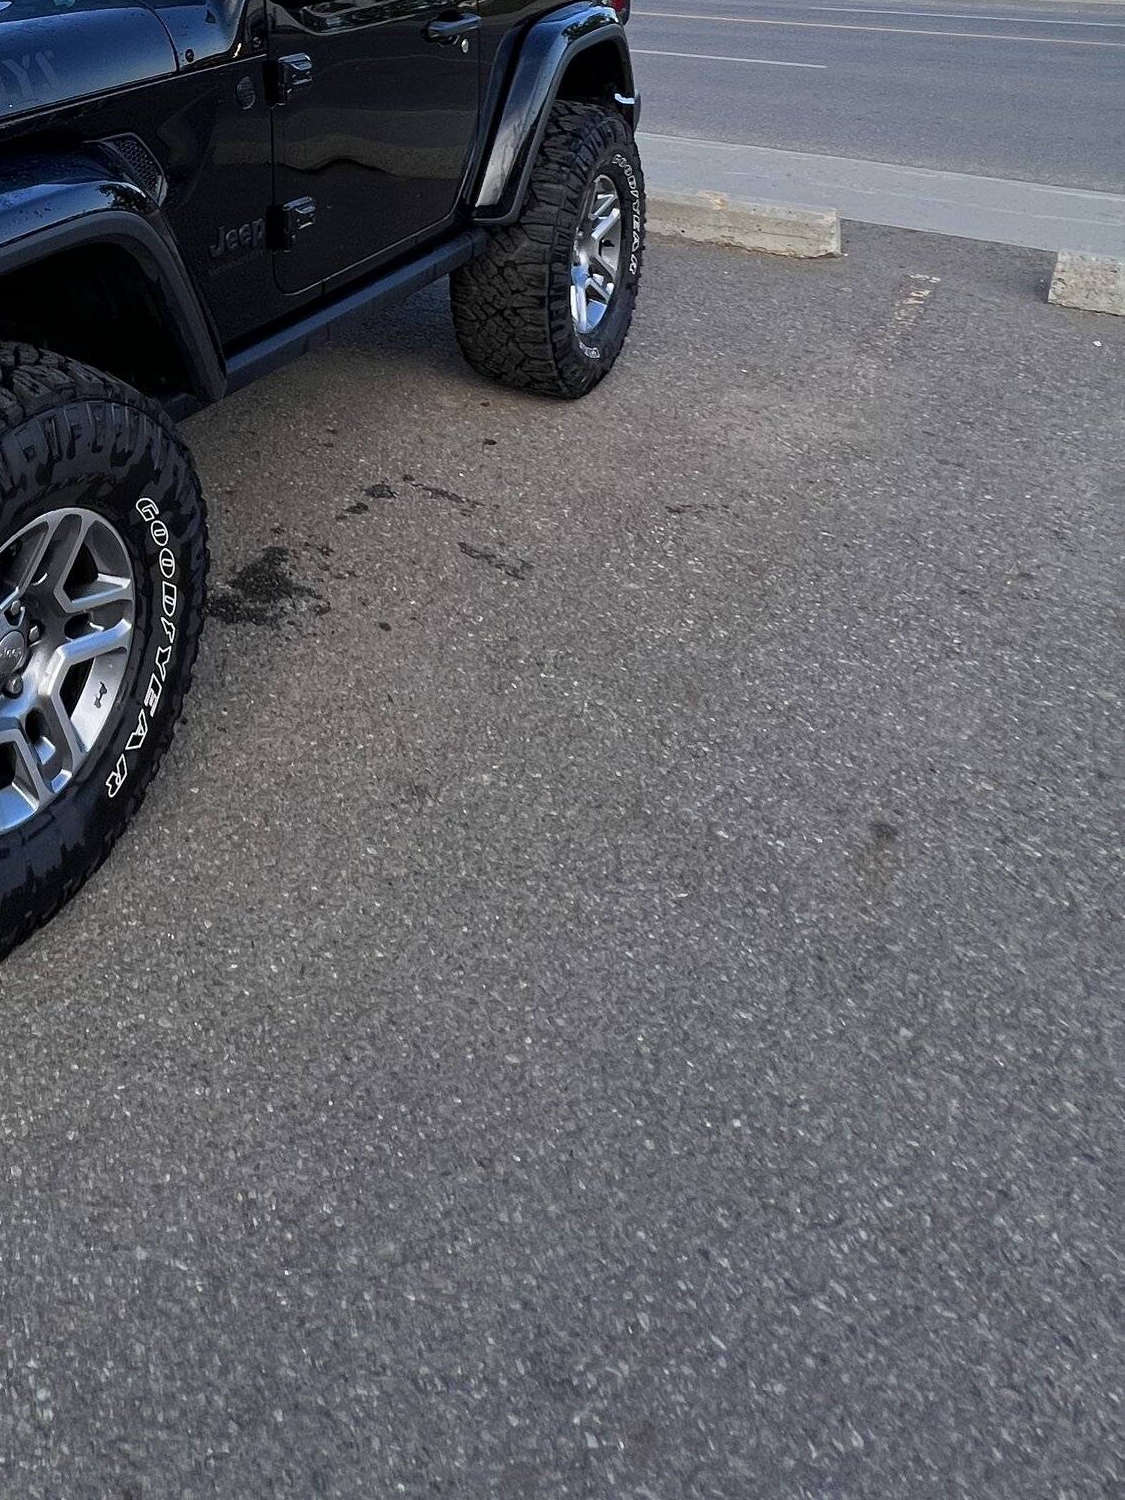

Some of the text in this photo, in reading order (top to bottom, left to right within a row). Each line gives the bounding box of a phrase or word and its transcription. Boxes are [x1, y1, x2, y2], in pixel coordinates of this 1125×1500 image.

[206, 217, 266, 258] Jeep
[612, 153, 641, 275] GOODYEAR
[105, 497, 177, 798] GOODYEAR
